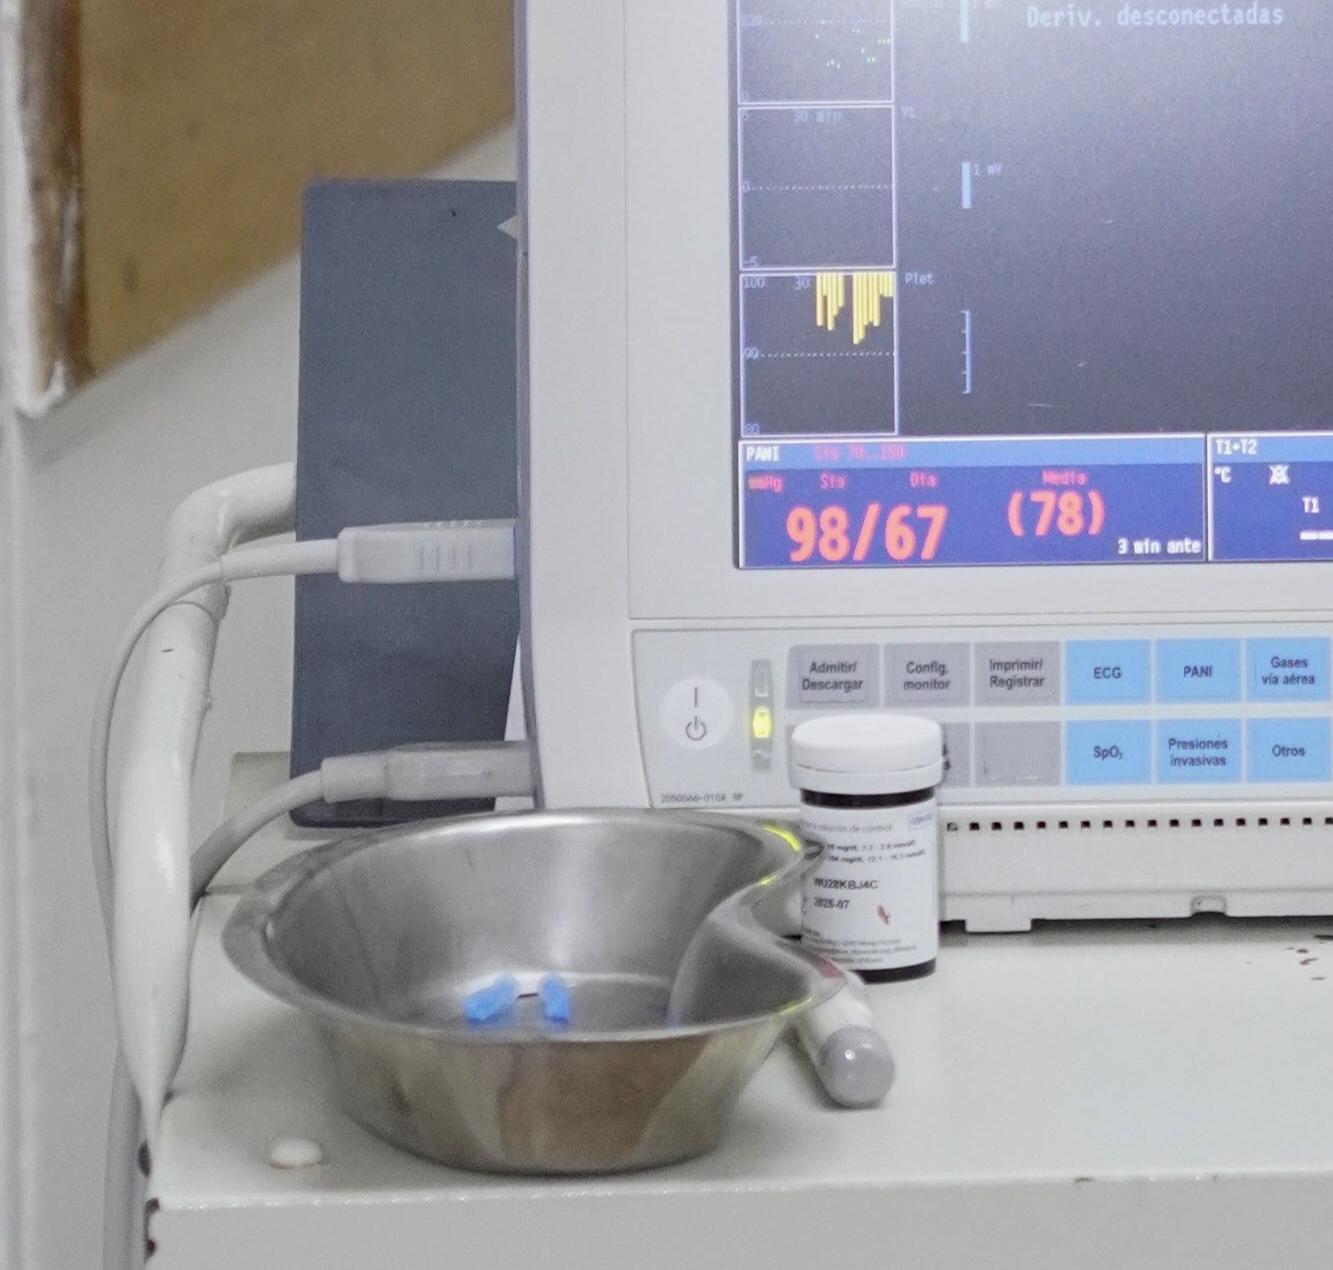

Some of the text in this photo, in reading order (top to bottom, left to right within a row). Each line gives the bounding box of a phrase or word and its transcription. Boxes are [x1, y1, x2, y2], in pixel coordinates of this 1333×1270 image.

[1026, 2, 1284, 28] Deriv. desconectadas
[905, 272, 935, 285] Plet
[746, 446, 779, 461] PANI
[1215, 439, 1258, 455] T1+T2
[1043, 470, 1088, 486] Media
[1214, 467, 1232, 484] °C
[1302, 497, 1320, 514] T1
[1007, 490, 1105, 537] (78)
[786, 503, 949, 562] 98/67
[1117, 538, 1201, 554] 3 min ante
[810, 661, 858, 674] Admitir/
[906, 662, 949, 676] Config.
[989, 659, 1044, 673] Imprimir/
[1270, 656, 1309, 669] Gases
[1093, 667, 1122, 679] ECG
[1183, 666, 1213, 678] PANI
[1261, 673, 1316, 685] vía aérea
[802, 679, 864, 693] Descargar
[903, 679, 950, 691] monitor
[989, 675, 1045, 689] Registrar
[1168, 738, 1228, 751] Presiones
[1271, 745, 1306, 757] Otros
[1170, 754, 1227, 767] invasivas
[862, 822, 893, 835] control
